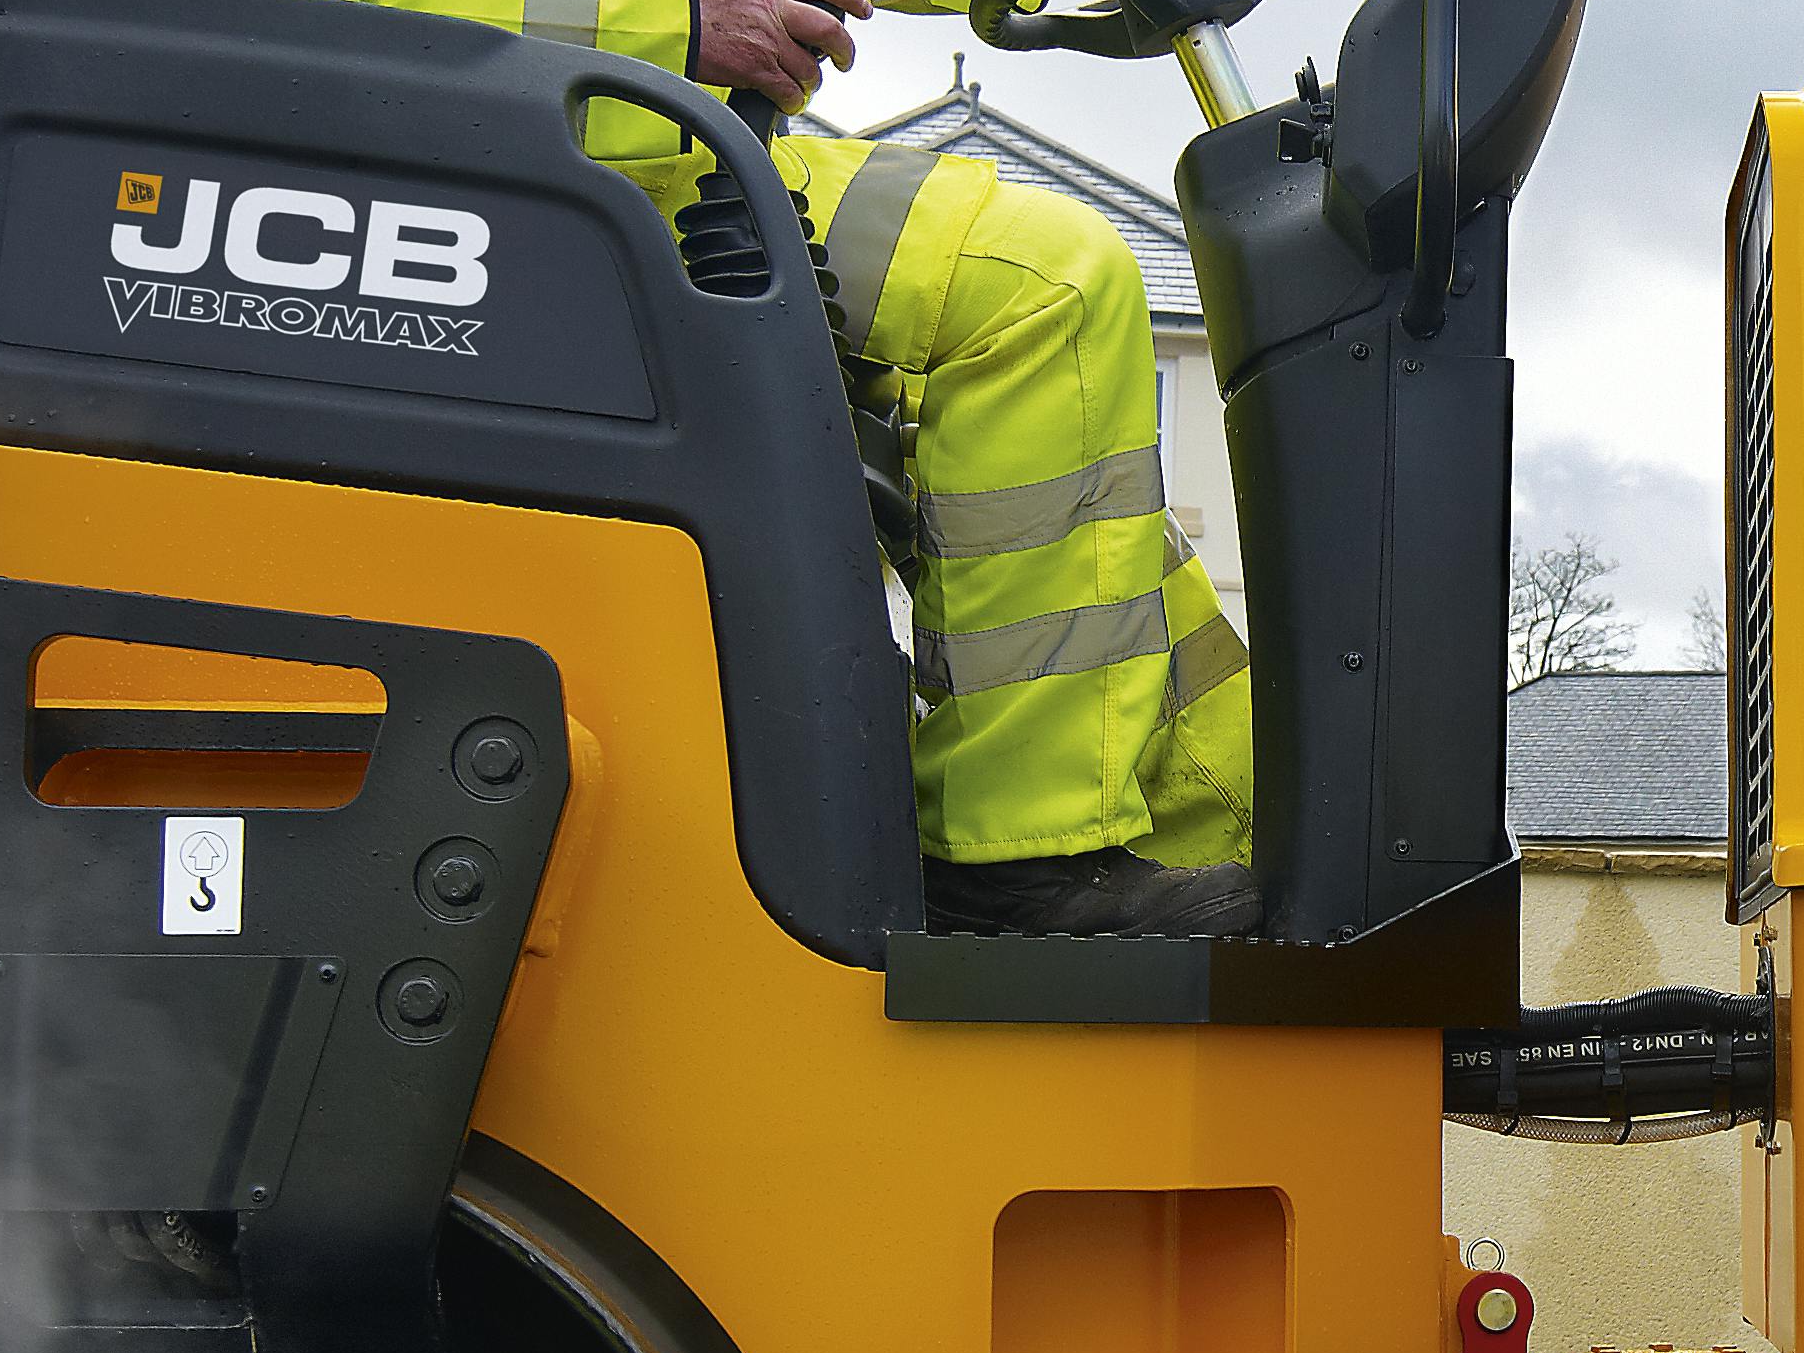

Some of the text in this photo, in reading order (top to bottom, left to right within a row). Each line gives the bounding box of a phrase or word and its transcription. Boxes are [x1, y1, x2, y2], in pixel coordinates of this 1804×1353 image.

[129, 181, 154, 201] JCB
[110, 179, 491, 307] JCB
[103, 276, 484, 356] VIBROMAX
[1547, 1043, 1574, 1059] EN
[1632, 1034, 1683, 1051] DN12
[1451, 1051, 1492, 1067] SAE
[1515, 1047, 1542, 1062] 85
